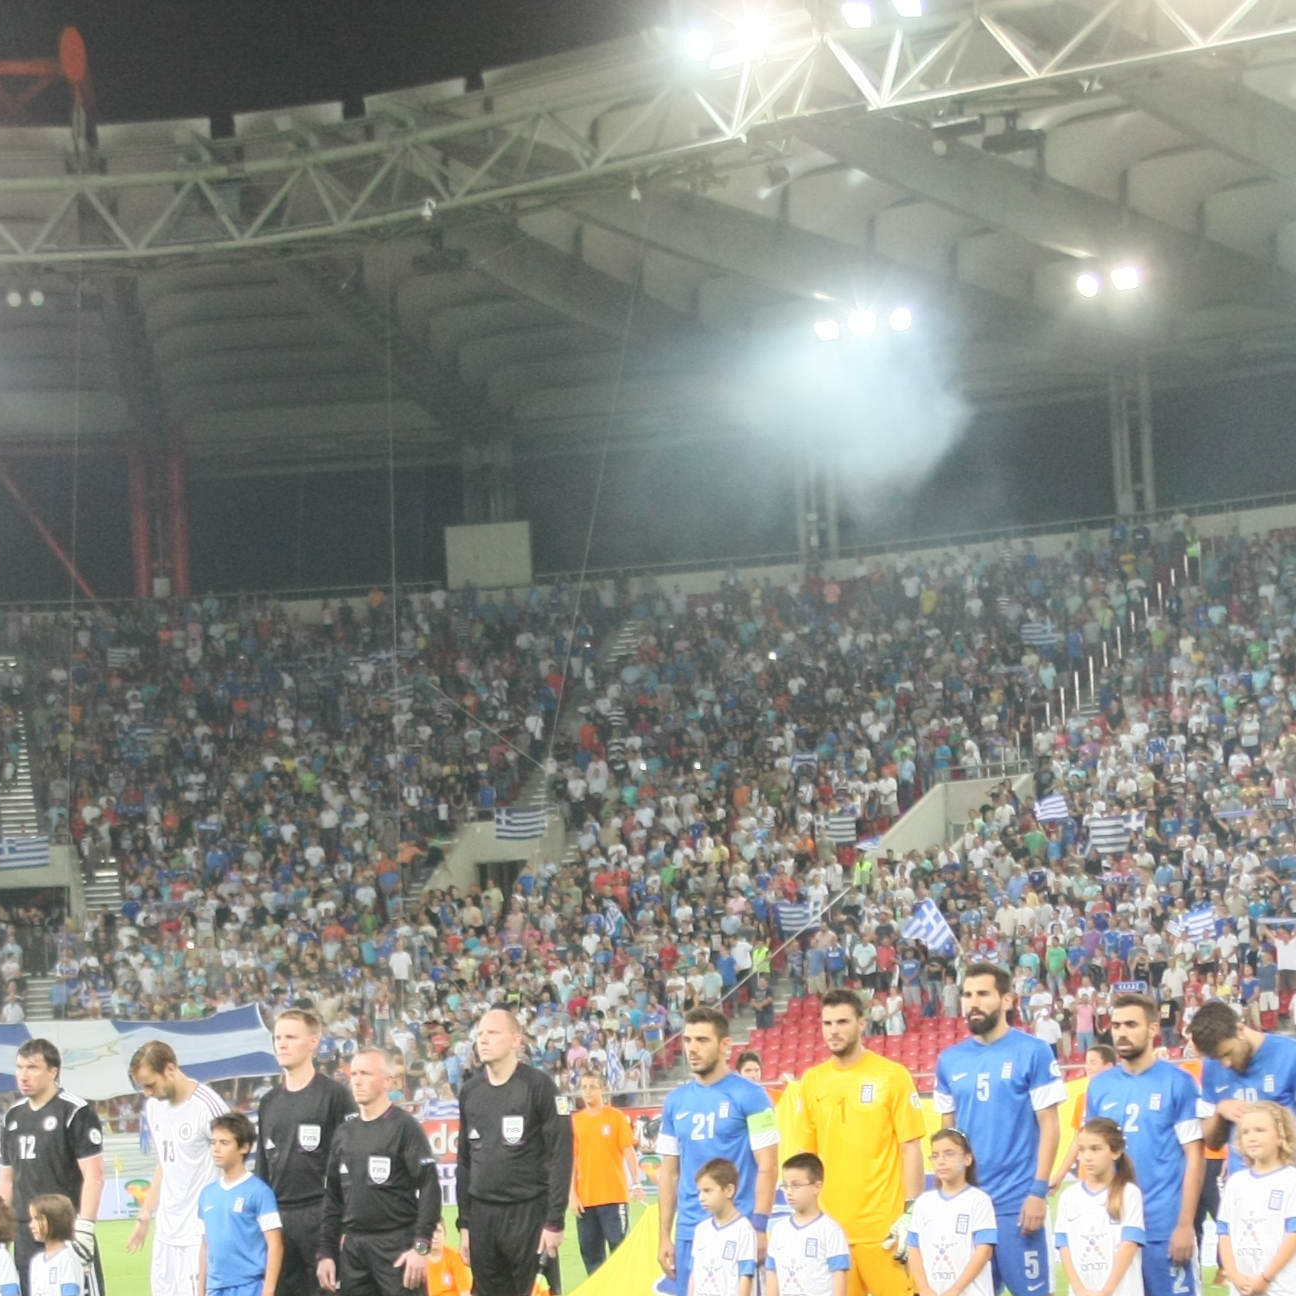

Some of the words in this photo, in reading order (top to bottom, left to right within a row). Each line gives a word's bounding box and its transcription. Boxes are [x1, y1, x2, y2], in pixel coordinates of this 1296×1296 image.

[976, 1072, 991, 1102] 5
[691, 1112, 716, 1141] 21
[1123, 1103, 1140, 1132] 2
[19, 1135, 37, 1160] 12
[162, 1140, 175, 1162] 13
[1023, 1250, 1040, 1280] 5
[1170, 1265, 1190, 1294] 2
